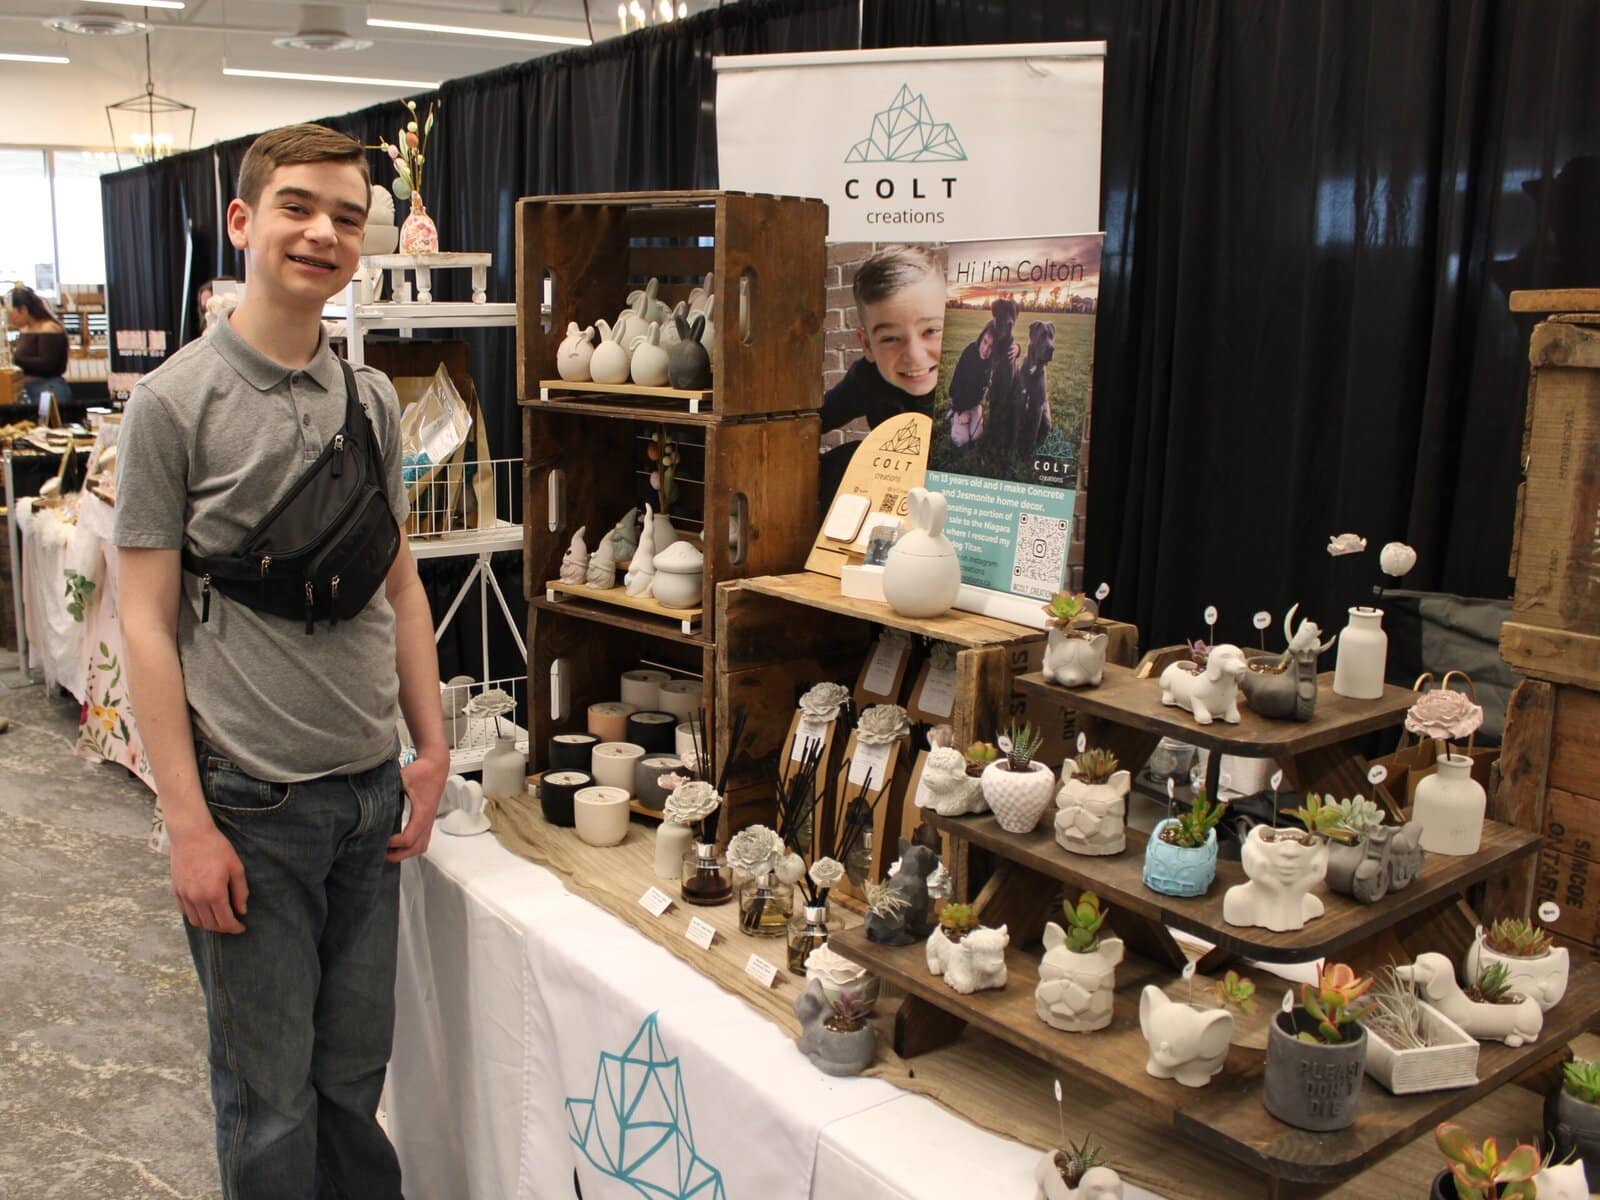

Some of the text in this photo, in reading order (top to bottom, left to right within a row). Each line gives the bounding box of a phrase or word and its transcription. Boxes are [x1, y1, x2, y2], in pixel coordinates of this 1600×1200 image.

[845, 178, 957, 199] COLT
[866, 209, 945, 224] creations
[957, 258, 1084, 283] Hi I'm Colton
[872, 457, 912, 472] COLT
[1034, 460, 1071, 474] COLT
[928, 472, 940, 481] I'm
[949, 475, 969, 486] years
[970, 478, 983, 487] old
[983, 480, 998, 490] and
[1004, 484, 1026, 494] make
[1027, 486, 1065, 500] Concrete
[956, 490, 995, 505] Jesmonite
[996, 496, 1019, 508] home
[979, 509, 1004, 520] portion
[1005, 511, 1013, 520] of
[963, 518, 971, 526] to
[972, 519, 983, 528] the
[984, 521, 1010, 533] Niagara
[972, 532, 999, 544] rescued
[999, 538, 1010, 548] my
[1564, 838, 1592, 910] SIMCOE
